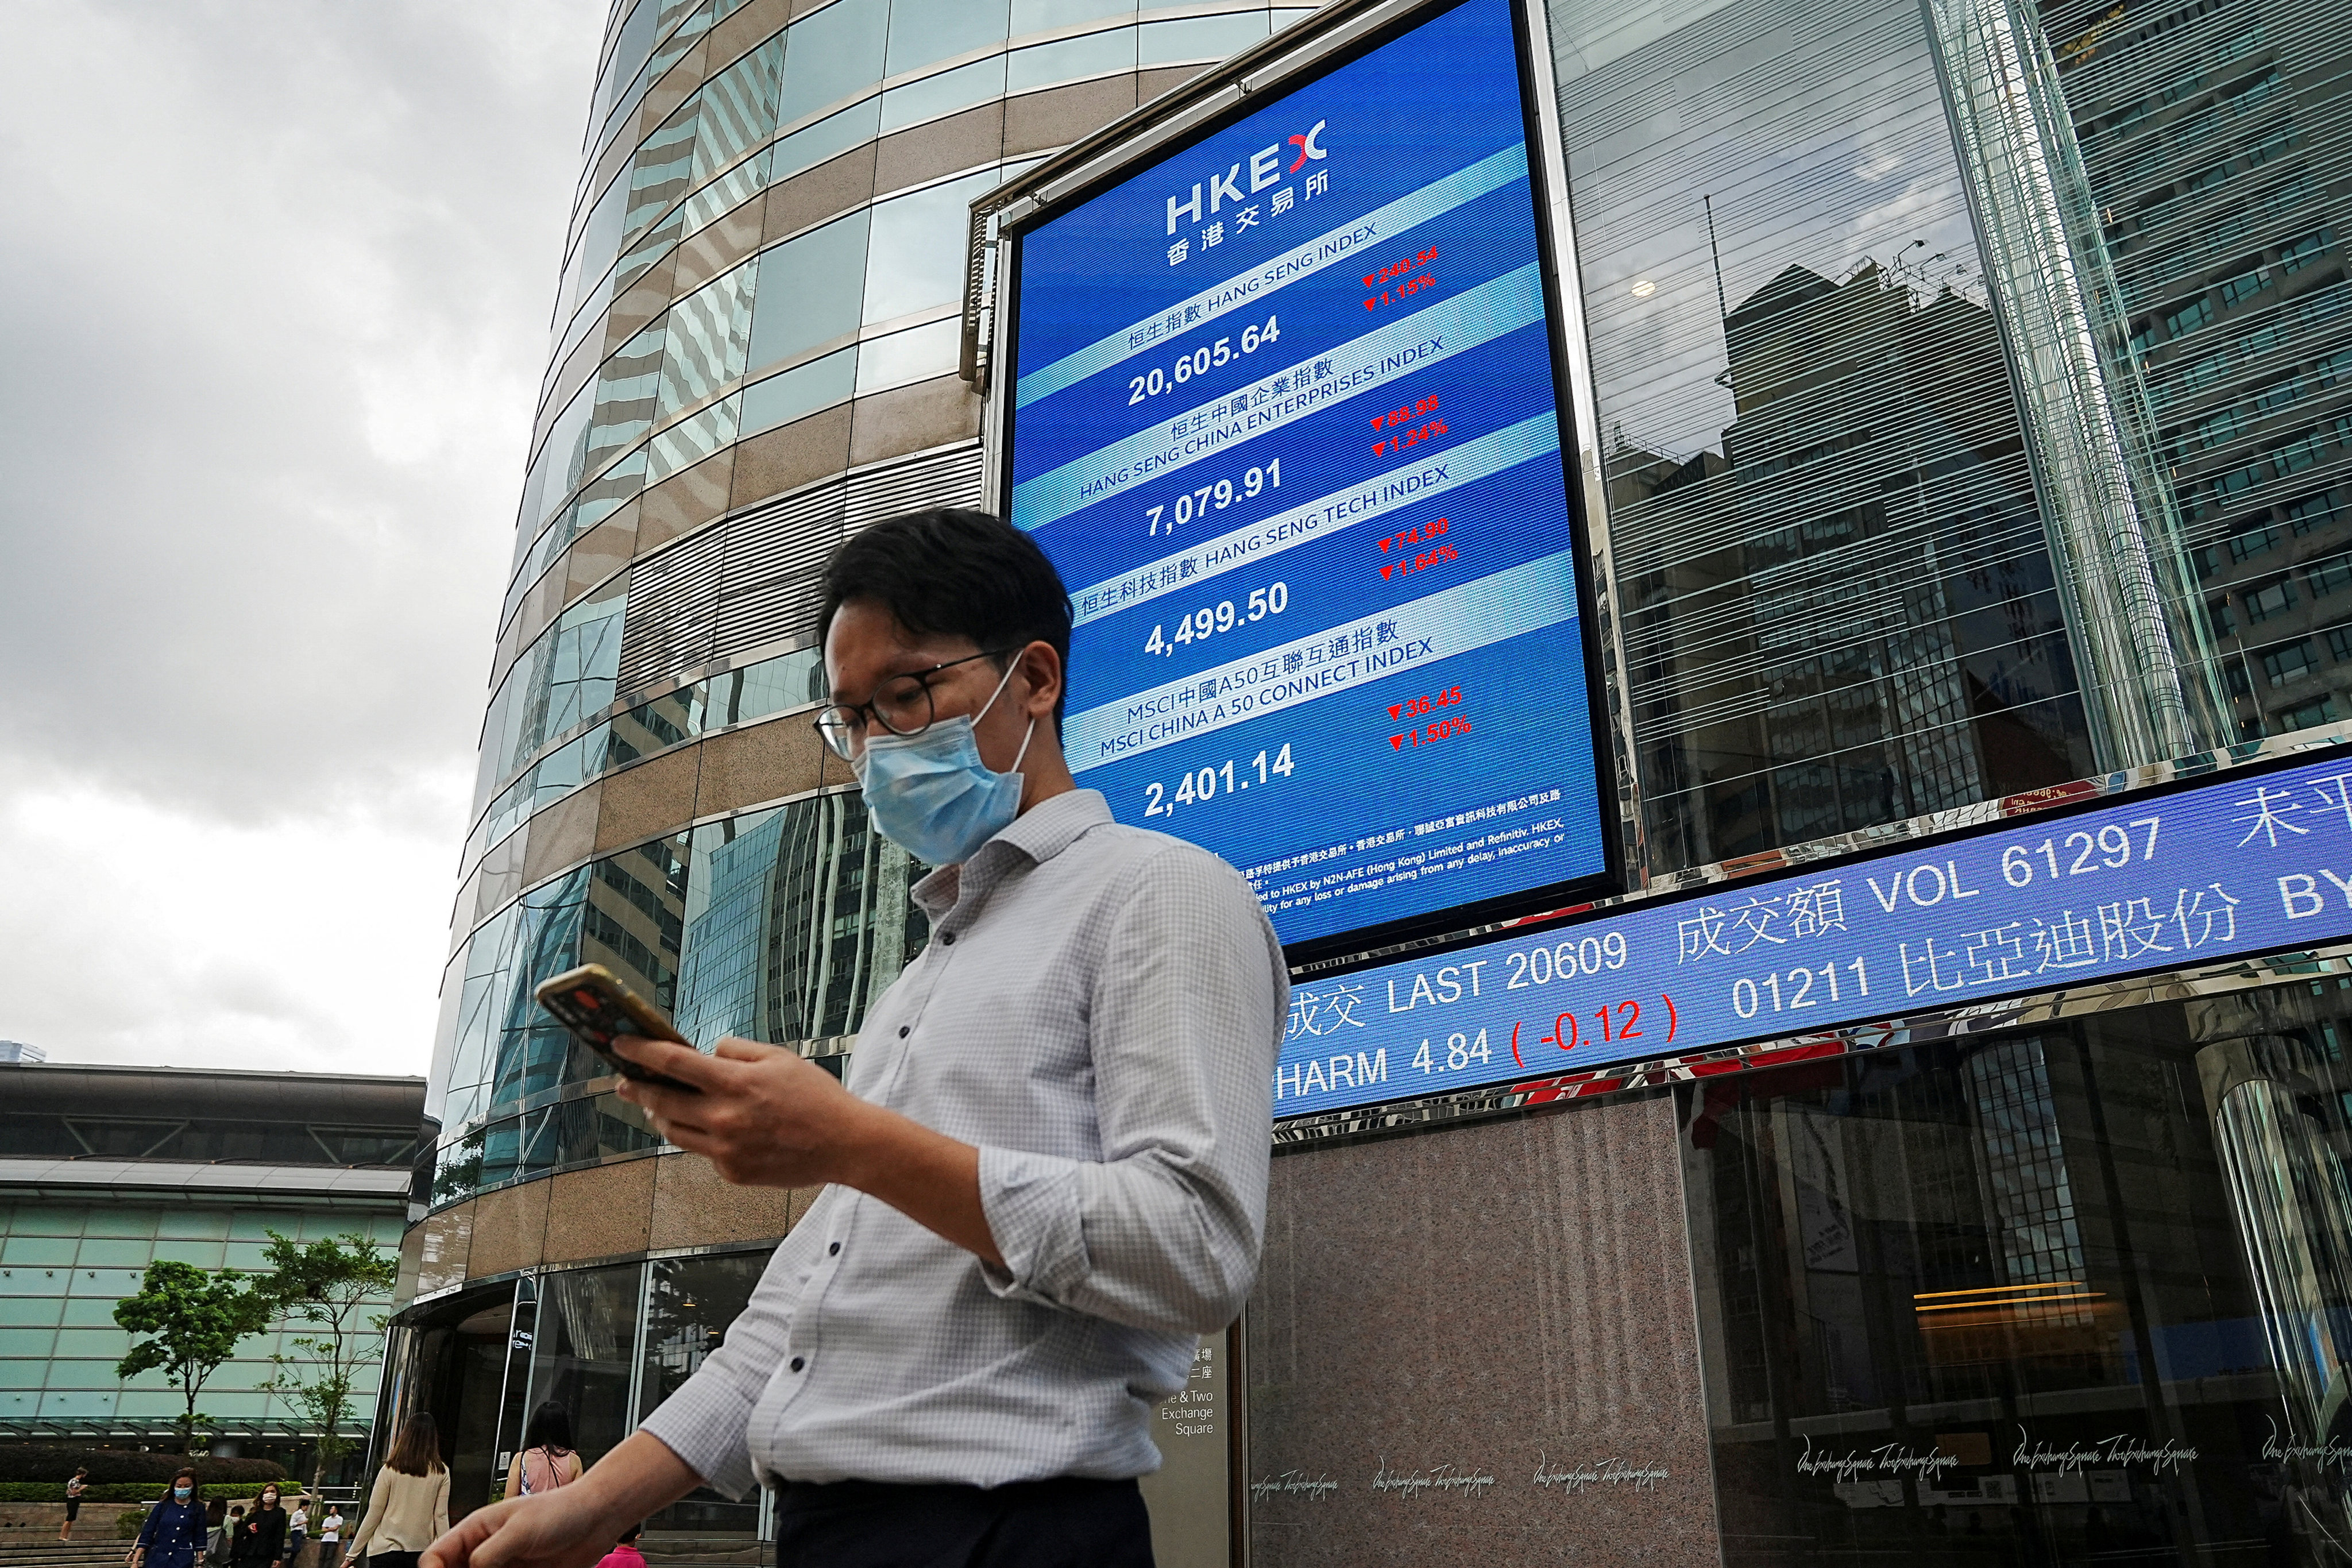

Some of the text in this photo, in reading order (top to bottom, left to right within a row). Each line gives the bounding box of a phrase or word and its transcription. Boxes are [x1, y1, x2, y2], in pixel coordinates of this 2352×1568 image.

[1167, 119, 1327, 235] HKEX
[1167, 169, 1329, 267] 香港交易所
[1128, 222, 1377, 350] 恒生指數 HANG SENG INDEX
[1378, 246, 1438, 283] 240.54
[1380, 272, 1436, 306] 1.15%
[1128, 315, 1280, 405] 20,605.64
[1080, 336, 1444, 500] HANG SENG CHINA ENTERPRISES INDEX
[1171, 357, 1333, 442] 恒生中國企業指數
[1388, 395, 1439, 427] 88.98
[1390, 418, 1448, 452] 1.24%
[1146, 458, 1281, 536] 7,079.91
[1395, 517, 1449, 549] 74.90
[1082, 465, 1450, 617] 恒生科技指數 HANG SENG TECH INDEX
[1397, 543, 1458, 576] 1.64%
[1145, 581, 1288, 658] 4,499.50
[1101, 637, 1433, 756] MSCI CHINA A 50 CONNECT INDEX
[1127, 619, 1399, 724] MSCI中國A50互聯互通指數
[1406, 686, 1462, 717] 36.45
[1409, 715, 1472, 747] 1.50%
[1144, 743, 1295, 818] 2,401.14
[1280, 900, 1293, 909] for
[1295, 895, 1312, 906] any
[1314, 891, 1331, 901] loss
[1334, 887, 1345, 896] or
[1347, 878, 1384, 893] damage
[1387, 868, 1417, 883] arising
[1420, 863, 1443, 875] from
[1447, 858, 1464, 870] any
[1467, 851, 1496, 864] delay,
[1498, 836, 1550, 856] inaccuracy
[1553, 833, 1565, 843] or
[1282, 882, 1308, 895] HKEX
[1310, 880, 1321, 890] by
[1323, 868, 1364, 886] N2N-AFE
[1366, 861, 1395, 877] (Hong
[1398, 852, 1426, 867] Kong)
[1428, 842, 1463, 860] Limited
[1466, 838, 1485, 850] and
[1488, 828, 1529, 845] Refinitiv.
[1281, 984, 1366, 1043] 成交
[1388, 960, 1487, 1013] LAST
[1506, 932, 1628, 990] 20609
[1677, 878, 1847, 965] 成交額
[1866, 860, 1979, 913] VOL
[2002, 817, 2160, 887] 61297
[1412, 1028, 1492, 1074] 4.84
[1732, 956, 1868, 1018] 01211
[1899, 882, 2241, 997] 比亞迪股份
[1161, 1407, 1213, 1420] Exchange
[1175, 1423, 1213, 1437] Square
[1180, 1391, 1188, 1403] &
[1190, 1390, 1213, 1402] Two
